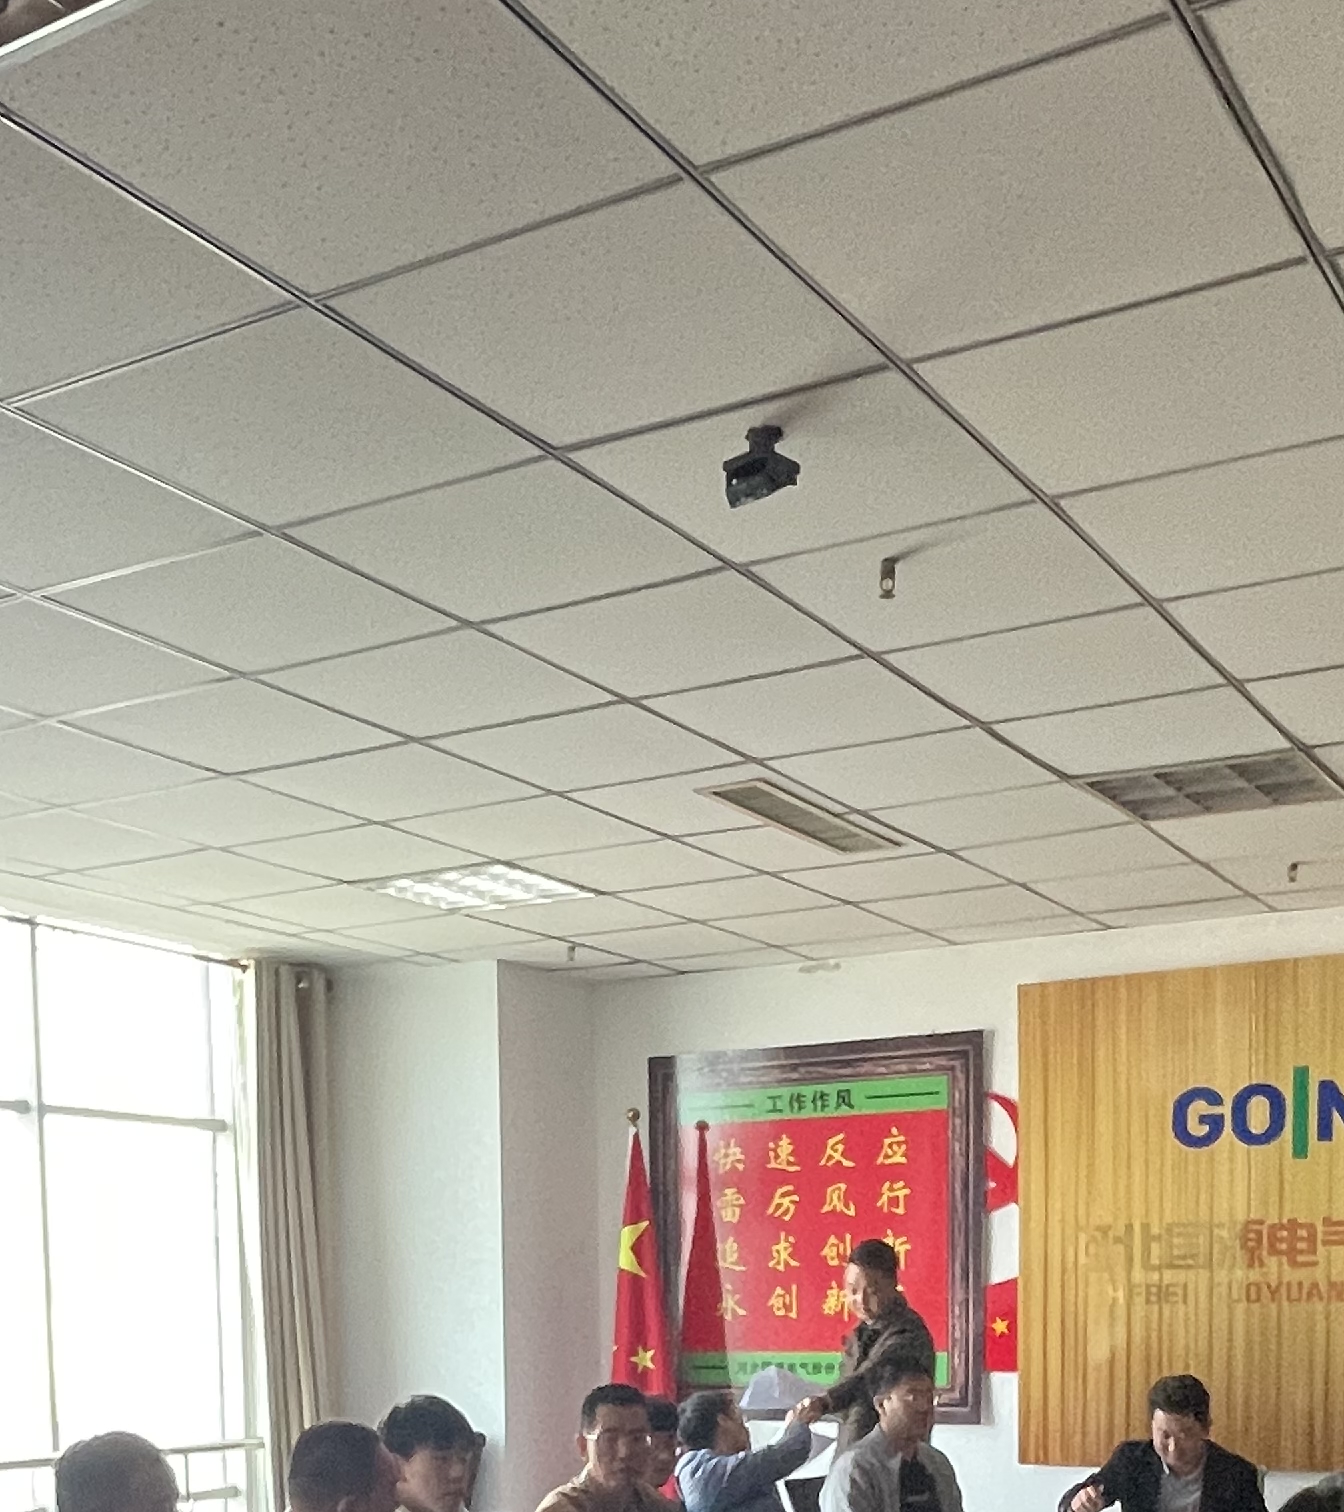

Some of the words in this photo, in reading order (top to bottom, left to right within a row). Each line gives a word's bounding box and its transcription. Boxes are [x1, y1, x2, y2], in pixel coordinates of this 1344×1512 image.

[765, 1088, 855, 1114] 工作作风
[712, 1126, 908, 1175] 快速反应
[716, 1180, 911, 1224] 雷厉风行
[716, 1280, 905, 1322] 永创新
